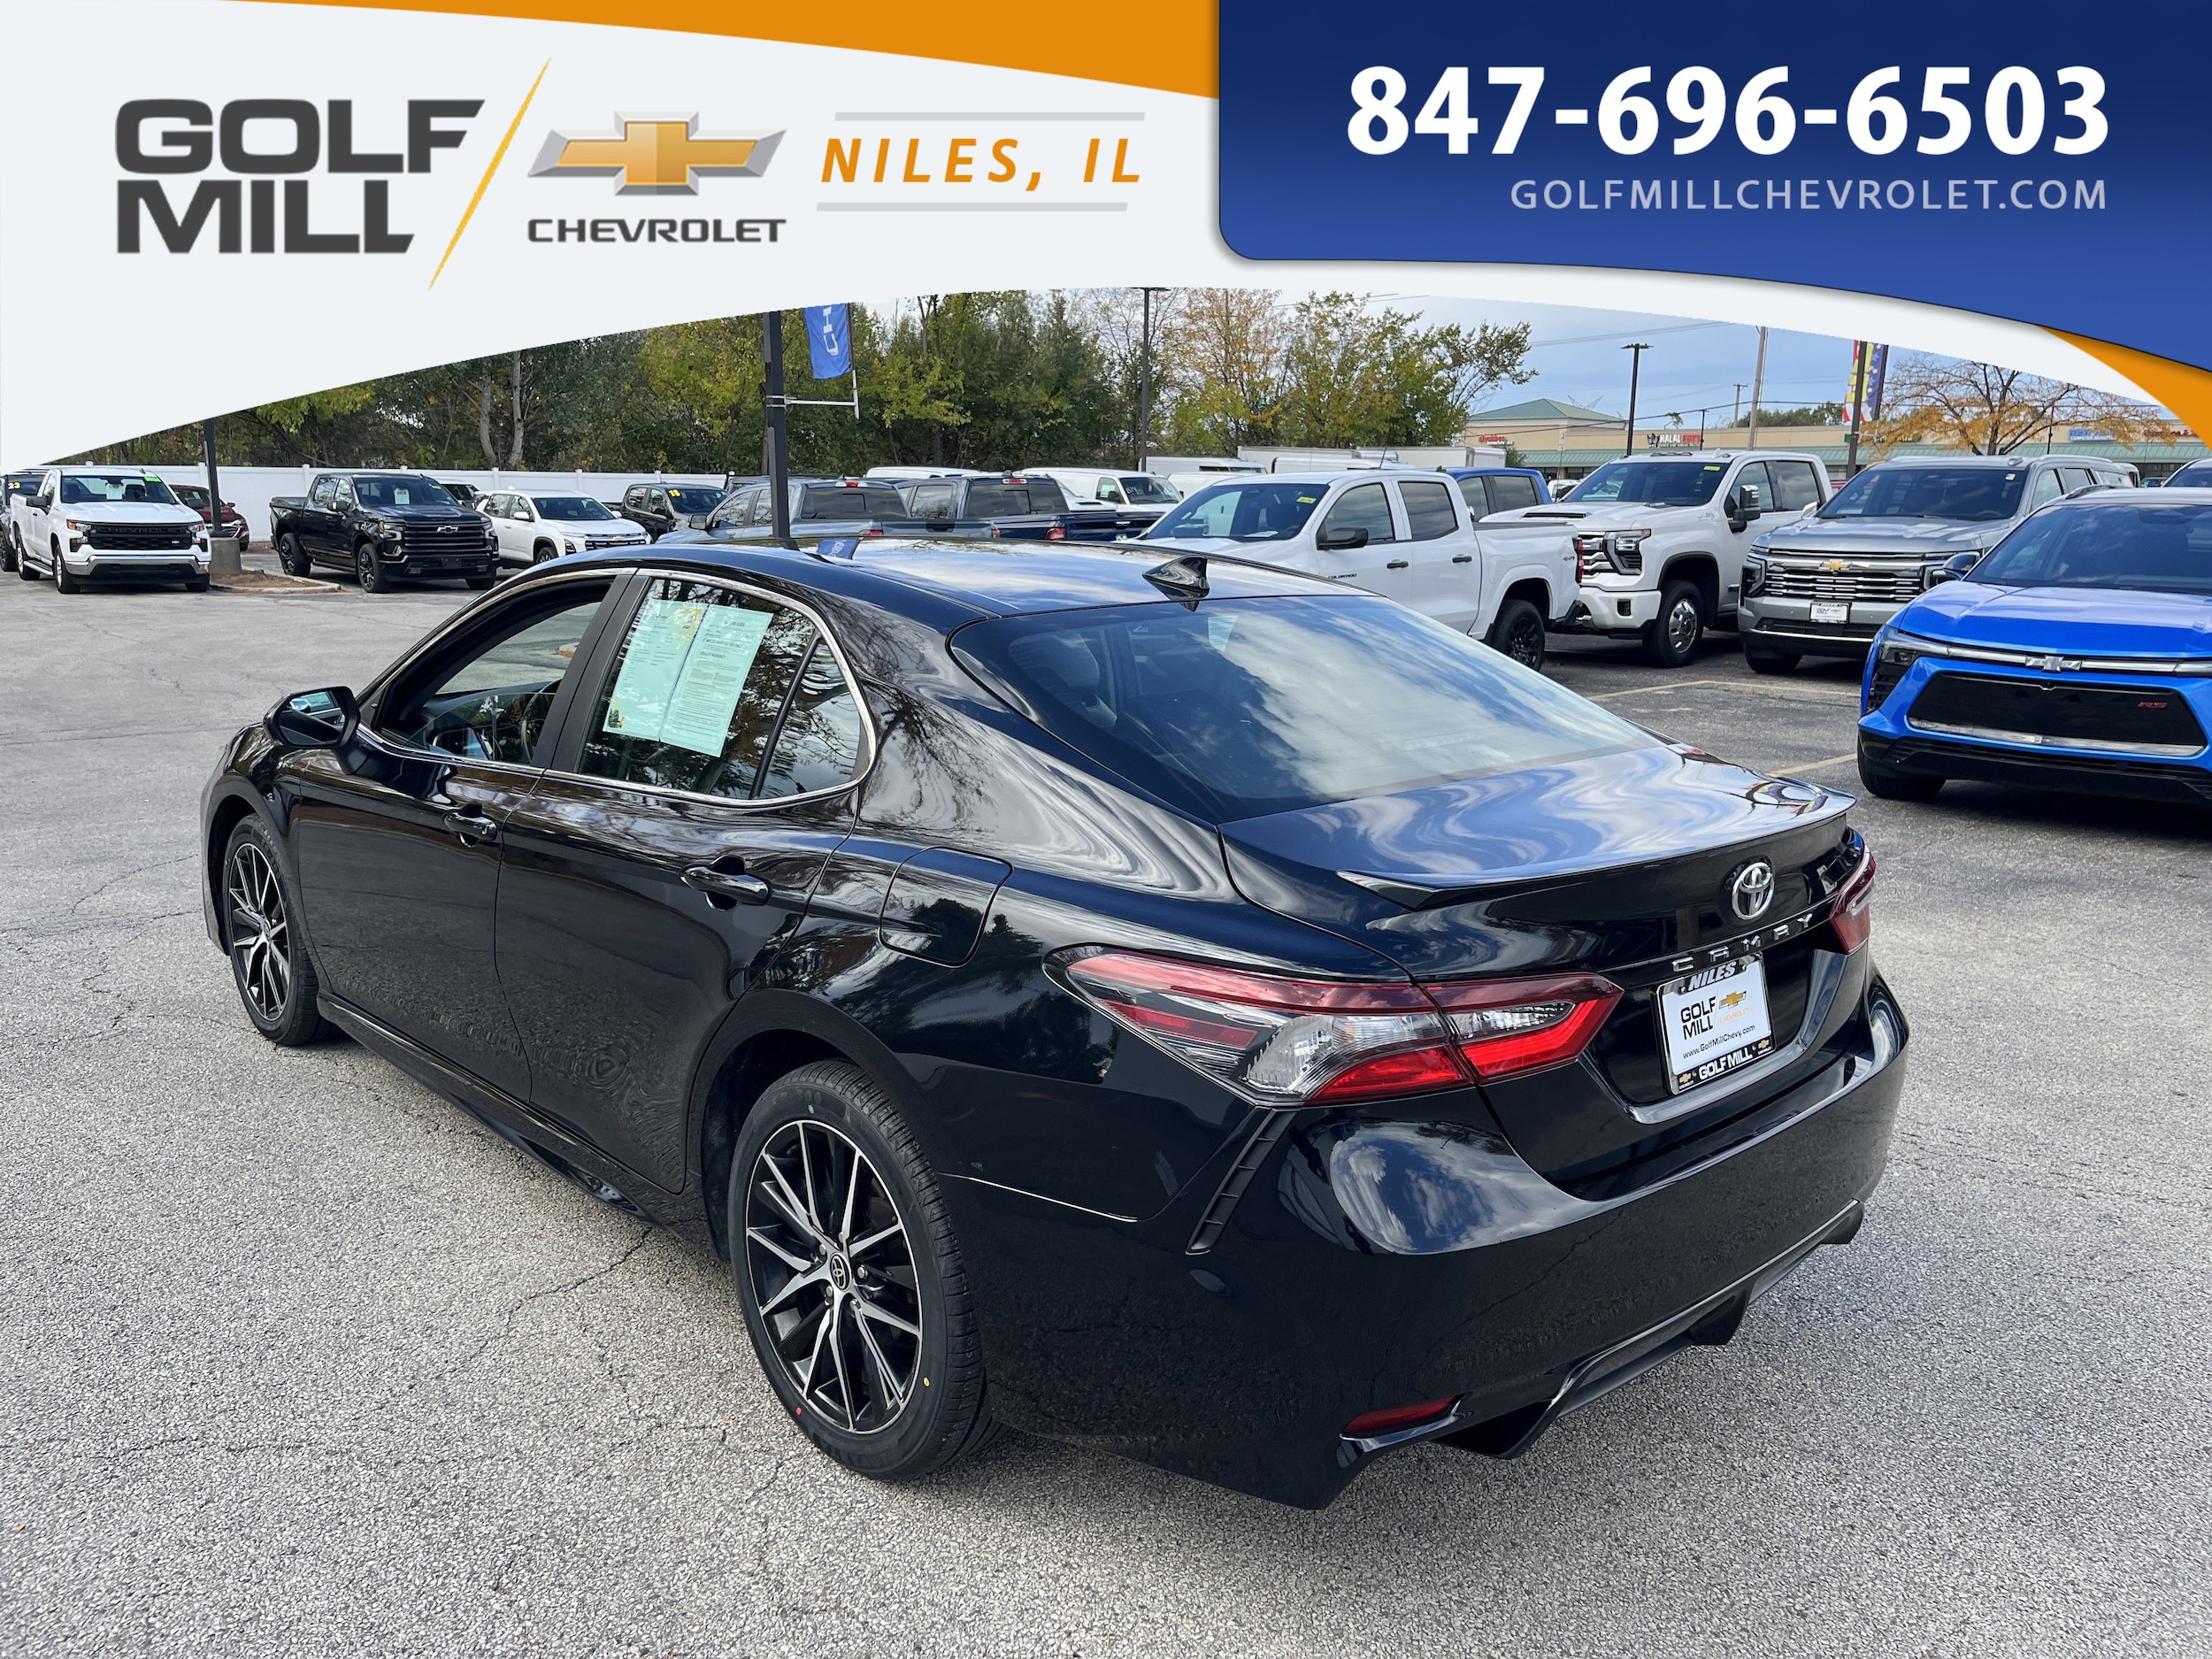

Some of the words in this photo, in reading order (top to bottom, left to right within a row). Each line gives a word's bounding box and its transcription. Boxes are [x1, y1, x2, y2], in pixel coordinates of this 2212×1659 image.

[1659, 434, 1680, 443] HALAL
[1671, 913, 1813, 972] CAMRY
[1688, 961, 1737, 991] NILES
[1680, 995, 1717, 1024] GOLF
[1682, 1016, 1714, 1041] MILL
[1682, 1025, 1755, 1059] www.GolfMillChevy.com
[1698, 1056, 1727, 1080] GOLF
[1726, 1047, 1753, 1068] MILL
